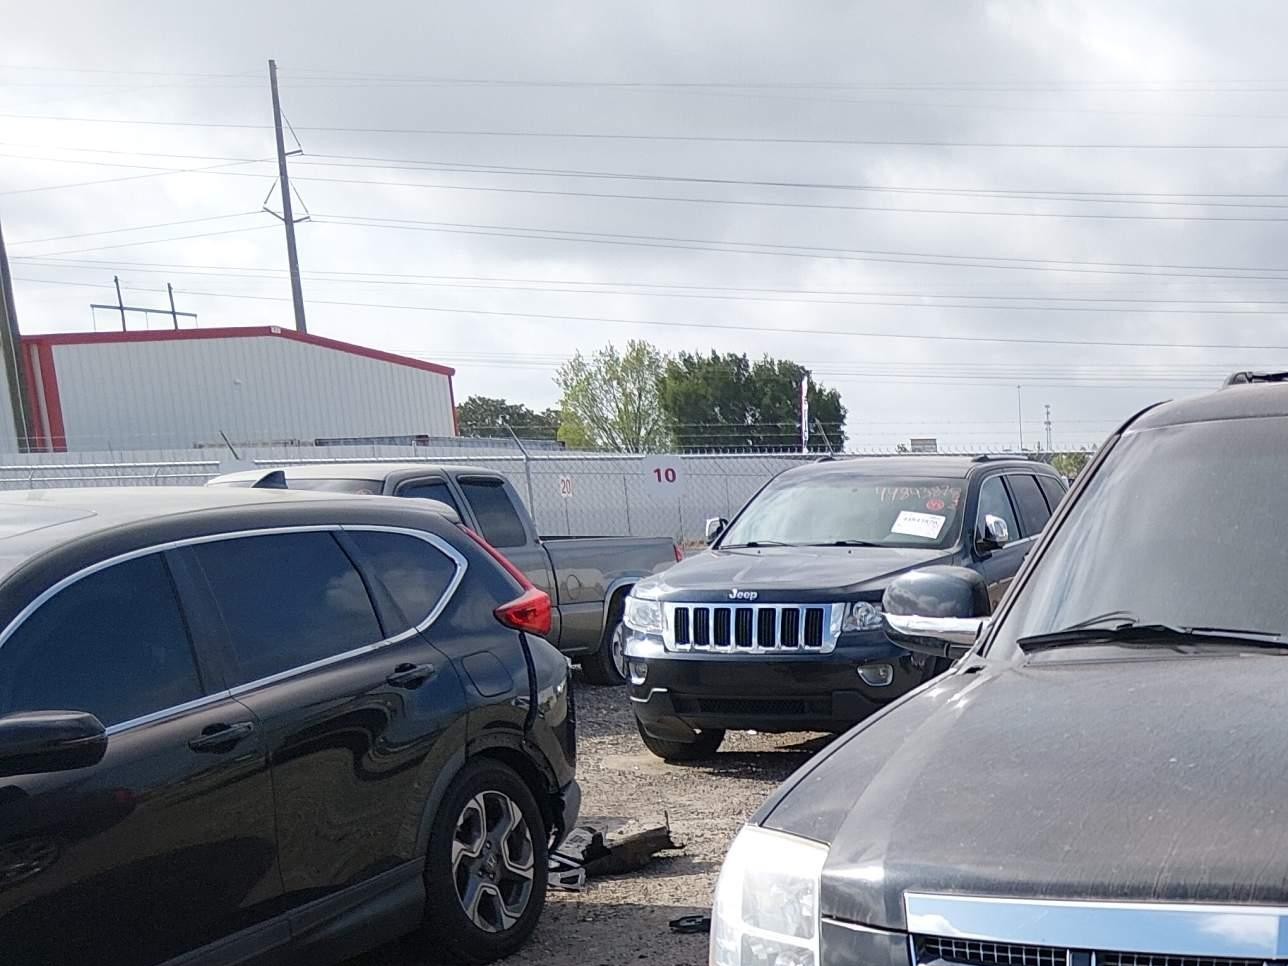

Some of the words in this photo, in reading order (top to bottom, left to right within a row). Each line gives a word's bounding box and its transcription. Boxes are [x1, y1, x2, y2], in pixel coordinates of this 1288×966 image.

[653, 468, 677, 483] 10
[560, 479, 571, 495] 20
[729, 588, 758, 601] Jeep
